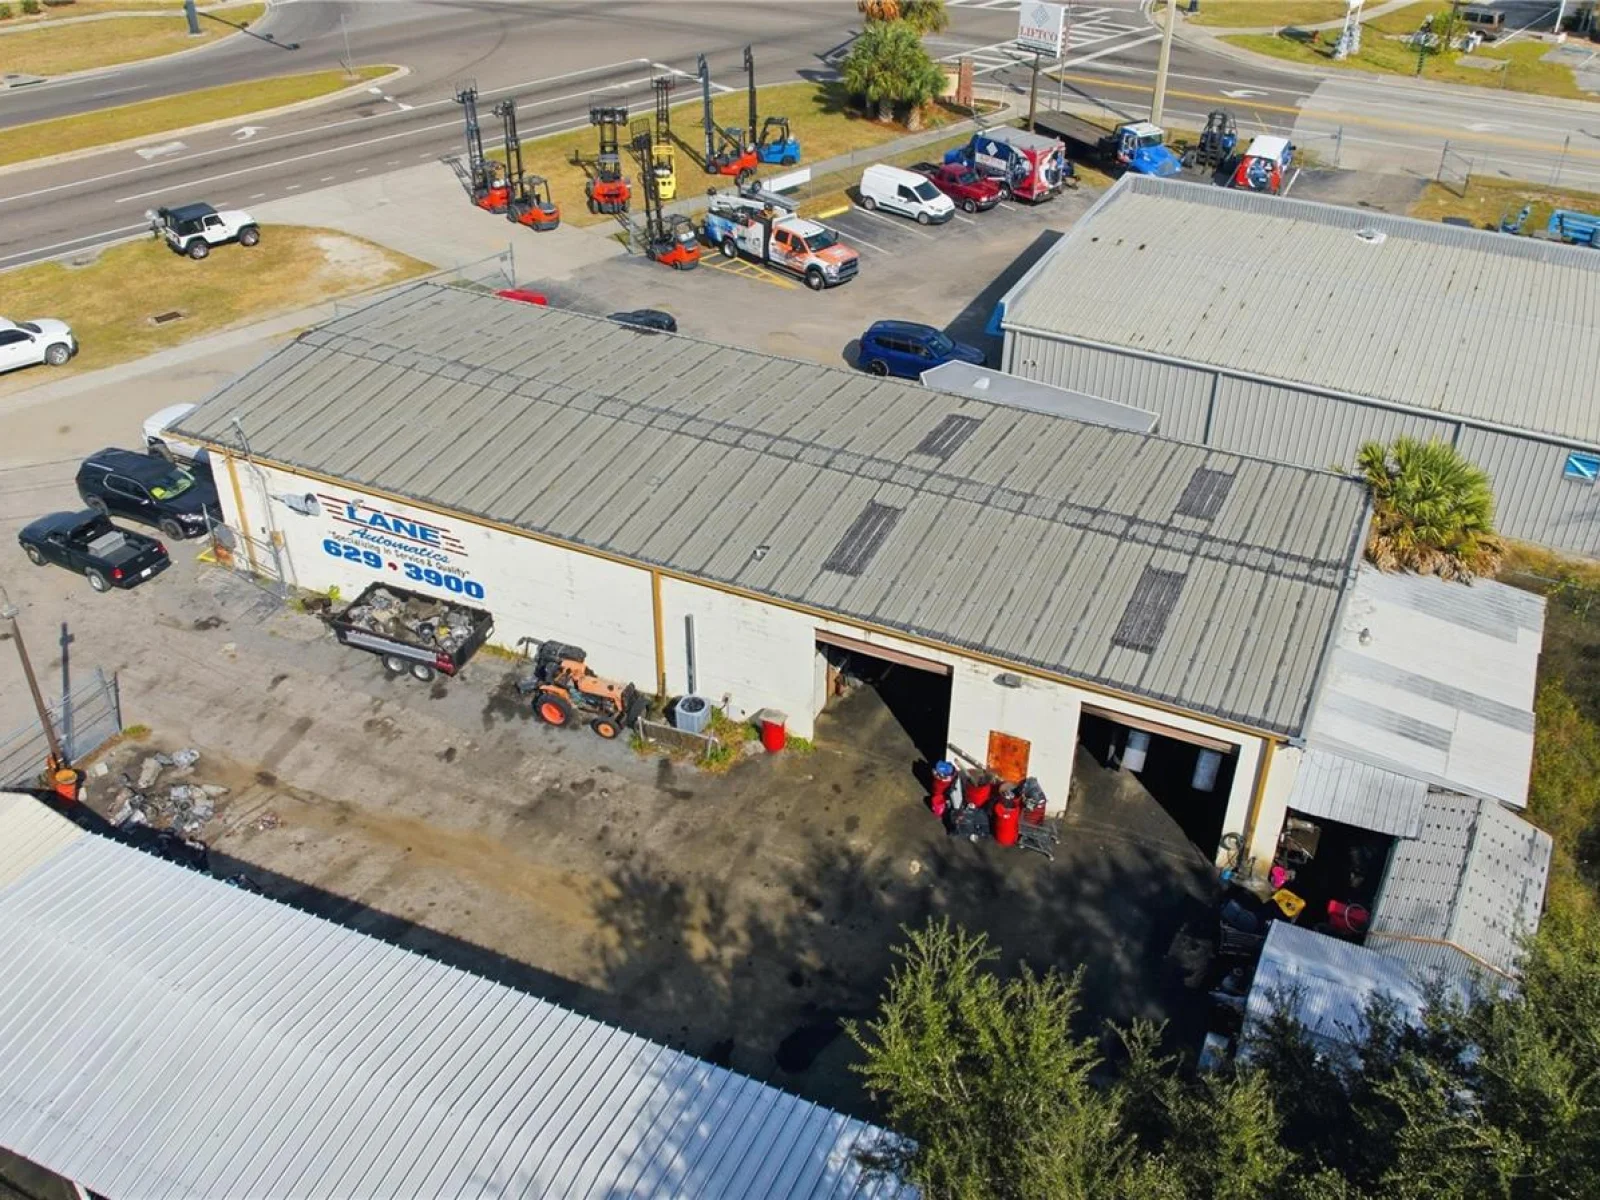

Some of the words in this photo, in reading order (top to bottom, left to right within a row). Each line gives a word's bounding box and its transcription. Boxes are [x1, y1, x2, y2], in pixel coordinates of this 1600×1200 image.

[346, 503, 441, 545] LANE
[350, 528, 449, 563] Automatics
[322, 538, 383, 569] 629
[403, 562, 485, 600] 3900
